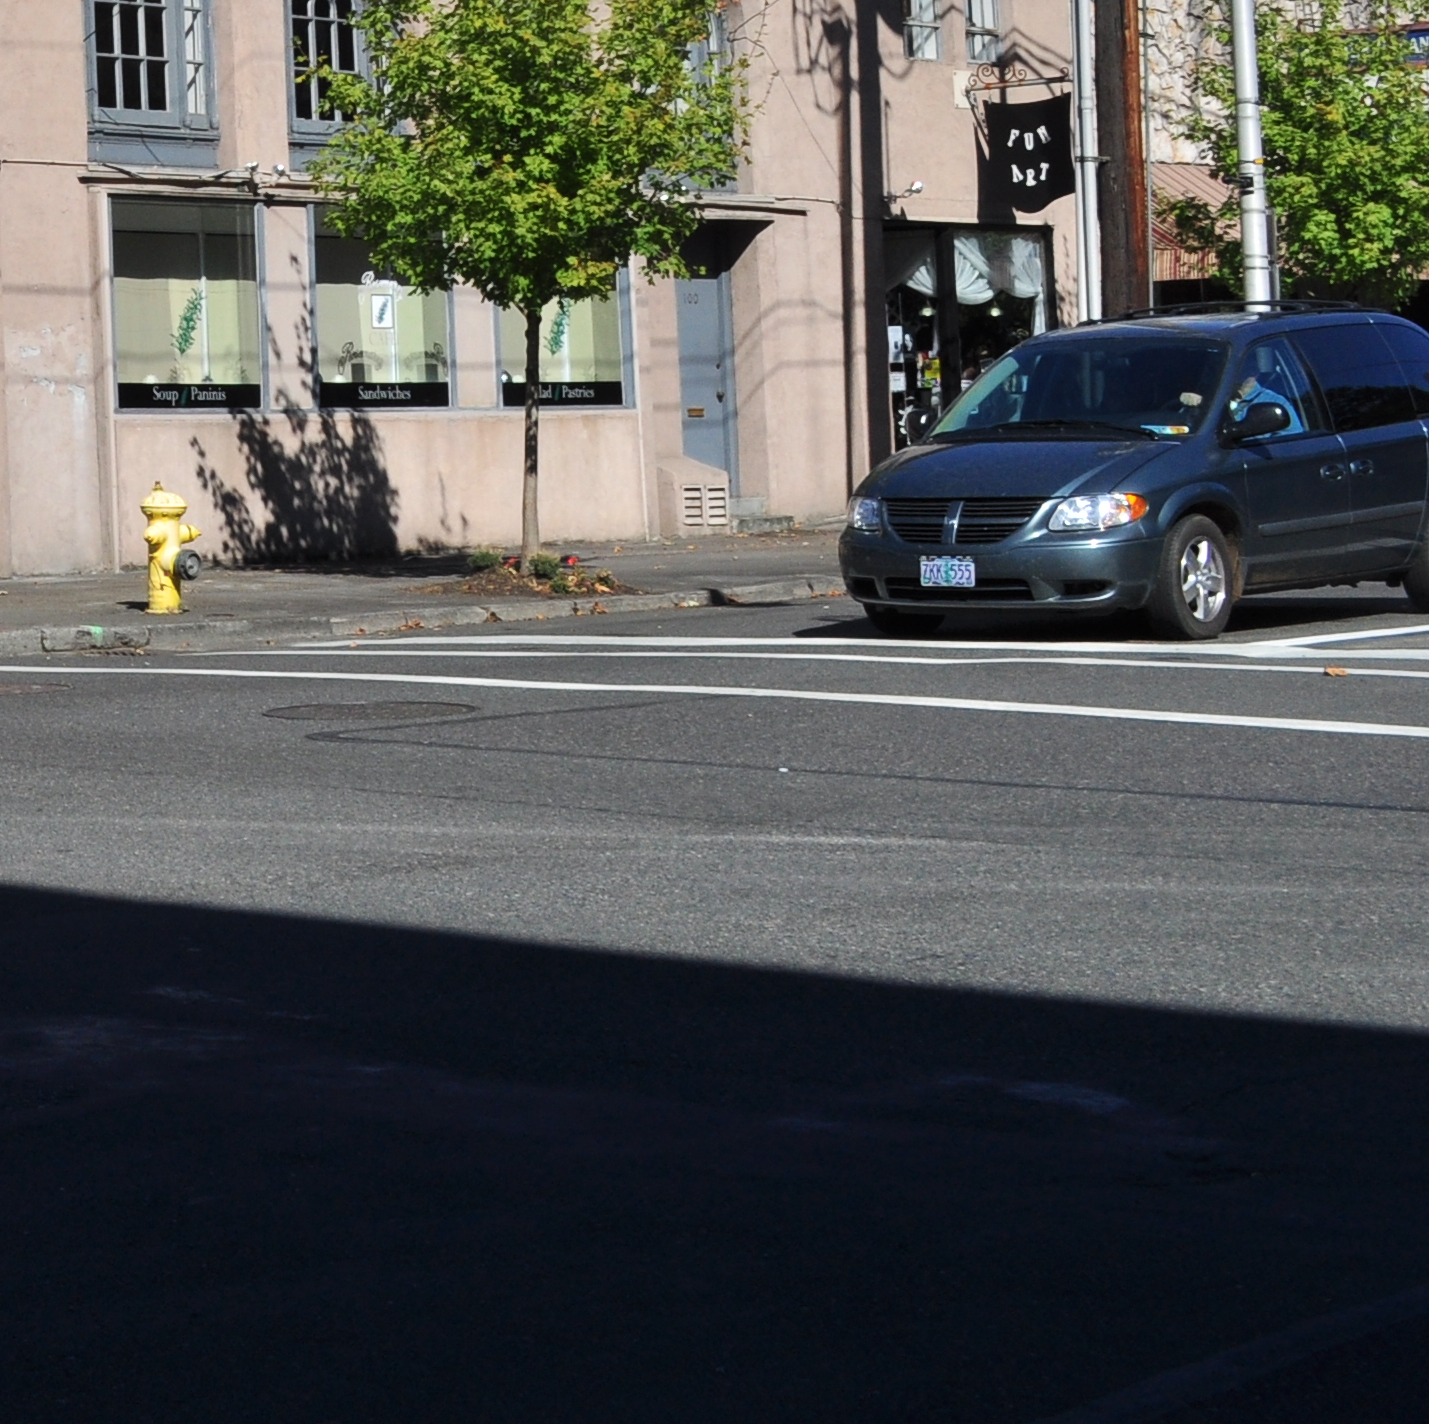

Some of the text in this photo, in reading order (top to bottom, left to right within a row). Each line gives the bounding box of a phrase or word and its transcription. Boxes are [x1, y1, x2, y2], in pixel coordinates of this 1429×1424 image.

[1007, 125, 1051, 151] FUN
[1011, 162, 1050, 186] ART
[152, 386, 227, 406] Soup Paninis
[358, 384, 412, 400] Sandwiches
[562, 385, 595, 398] Pastries
